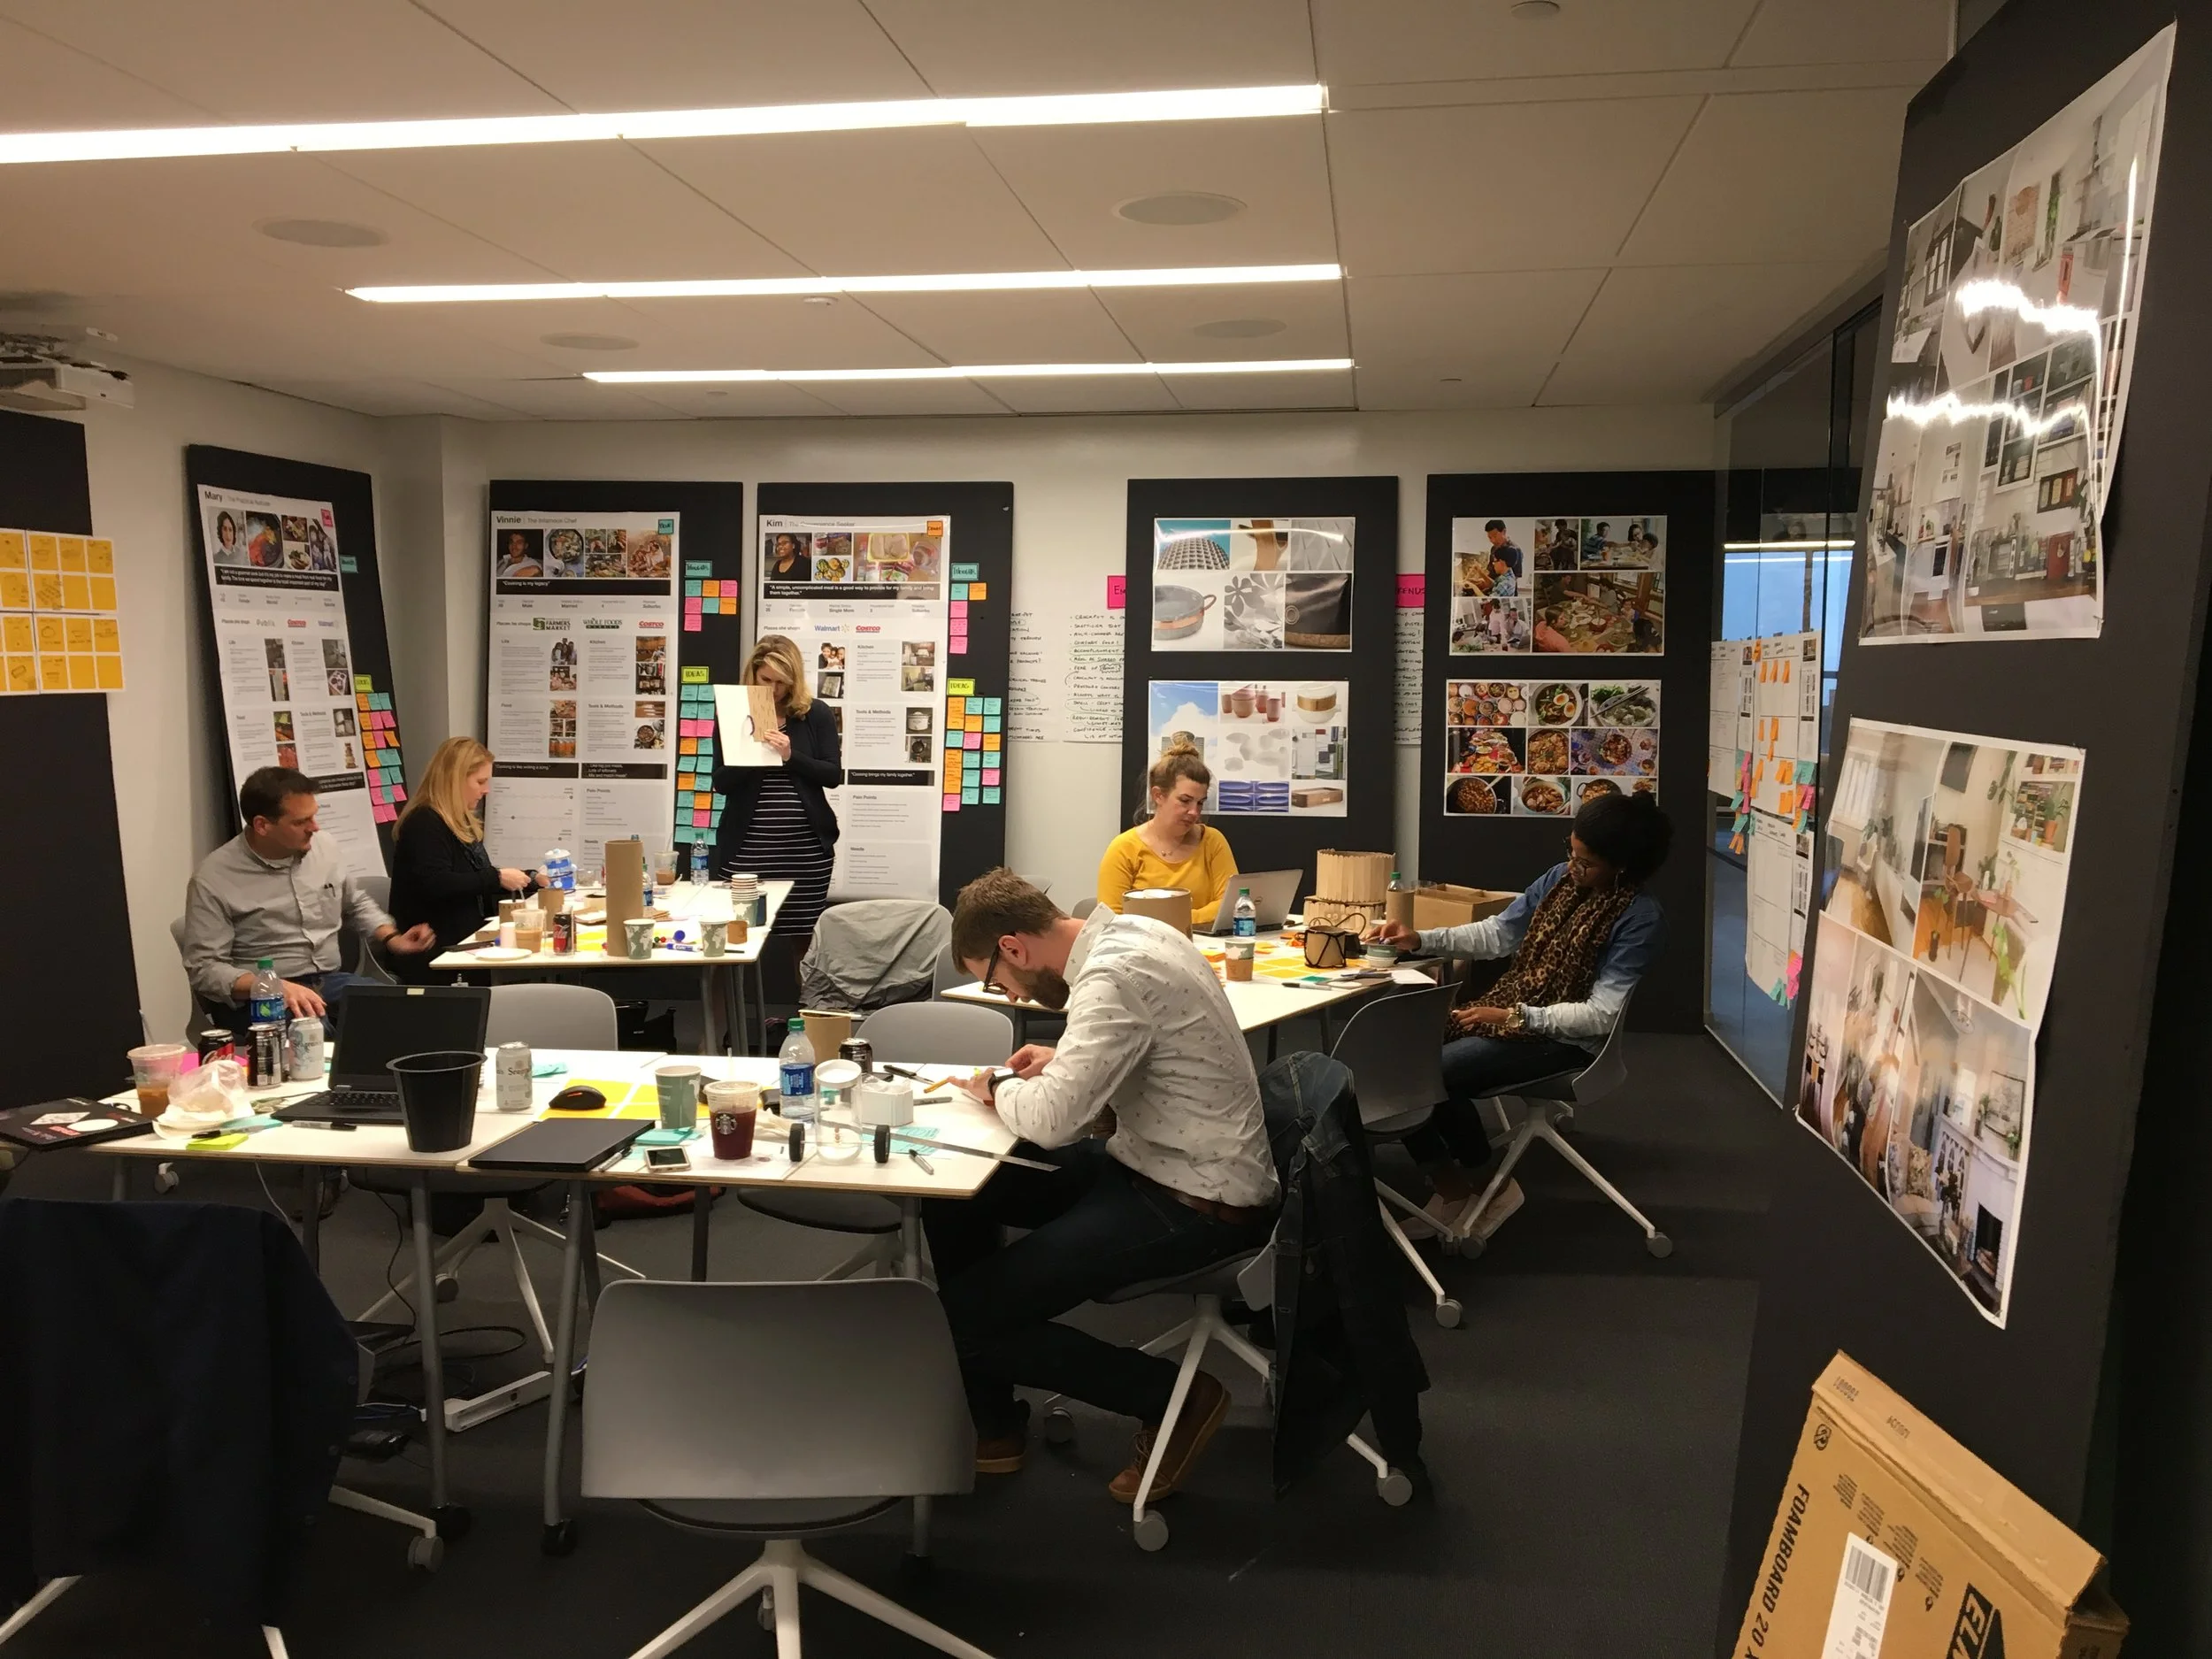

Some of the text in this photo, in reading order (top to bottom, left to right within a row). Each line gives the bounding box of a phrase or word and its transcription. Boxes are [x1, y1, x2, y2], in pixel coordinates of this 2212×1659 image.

[204, 490, 223, 503] Mary
[1763, 1483, 1810, 1614] FOAMBOARD
[1752, 1612, 1770, 1647] 20
